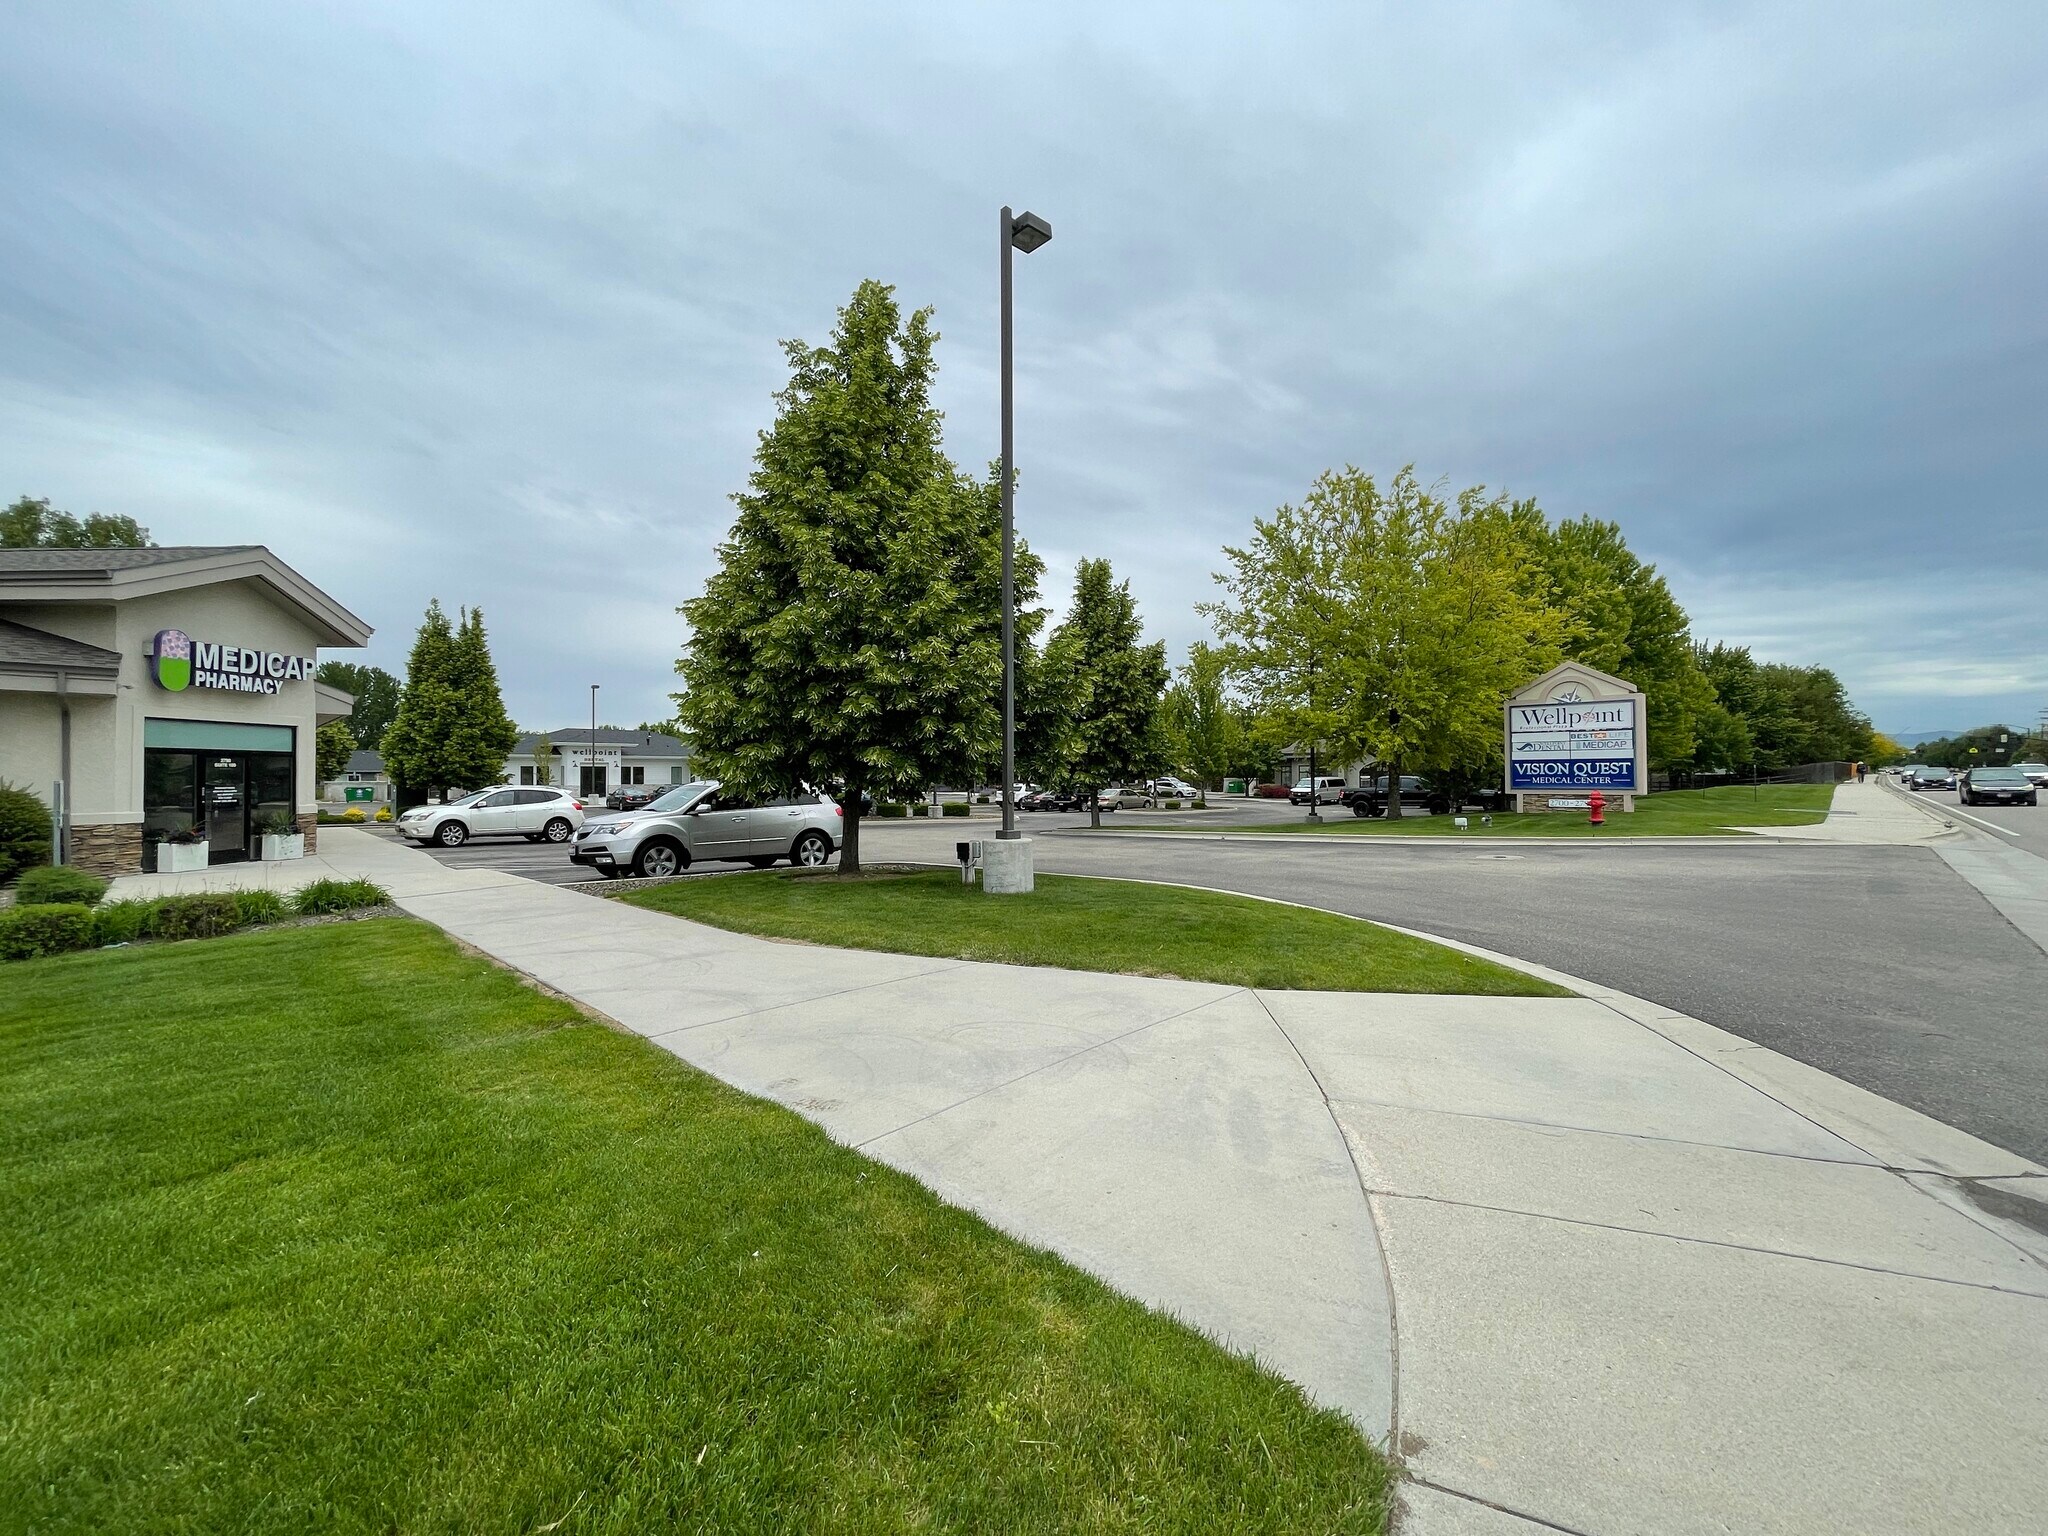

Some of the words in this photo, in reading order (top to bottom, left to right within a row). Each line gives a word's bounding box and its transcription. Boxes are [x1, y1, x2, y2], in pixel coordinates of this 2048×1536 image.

[195, 641, 316, 681] MEDICAP
[195, 671, 283, 695] PHARMACY
[1520, 705, 1625, 728] Wellpoint
[1582, 741, 1627, 749] MEDICAP
[1514, 762, 1570, 775] VISION
[1573, 762, 1631, 777] QUEST
[1532, 776, 1572, 784] MEDICAL
[1573, 776, 1612, 784] CENTER
